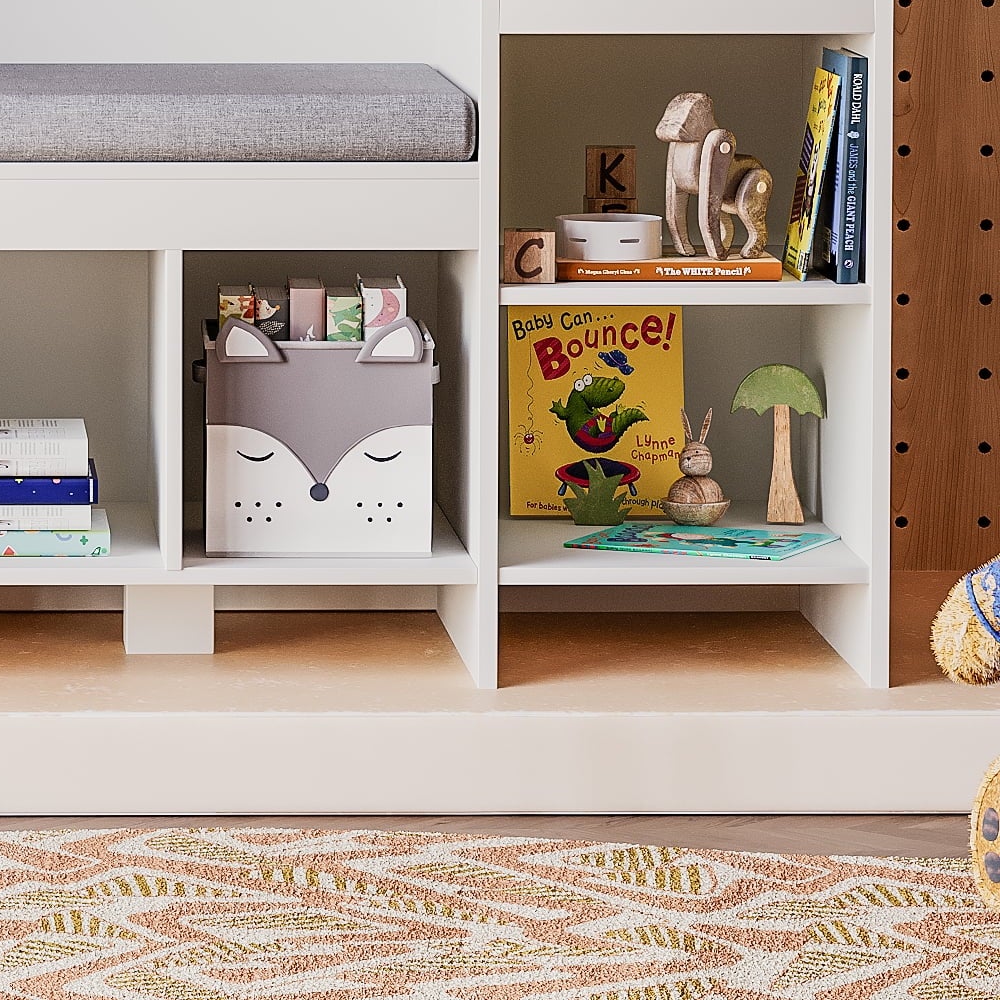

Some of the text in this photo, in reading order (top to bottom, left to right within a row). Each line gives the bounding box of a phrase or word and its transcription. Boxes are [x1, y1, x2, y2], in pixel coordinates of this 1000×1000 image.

[850, 73, 863, 125] ROALD DAHL
[600, 152, 627, 193] K
[844, 143, 859, 251] JAMES and the GIANT PEACH
[514, 238, 544, 279] C
[663, 267, 743, 276] The WHITE Pencil
[512, 313, 553, 341] Baby
[533, 312, 677, 381] Bounce!
[636, 434, 676, 450] Lynne
[631, 449, 681, 464] Chapman
[526, 501, 538, 509] For
[538, 502, 562, 511] babies
[651, 500, 664, 509] pla
